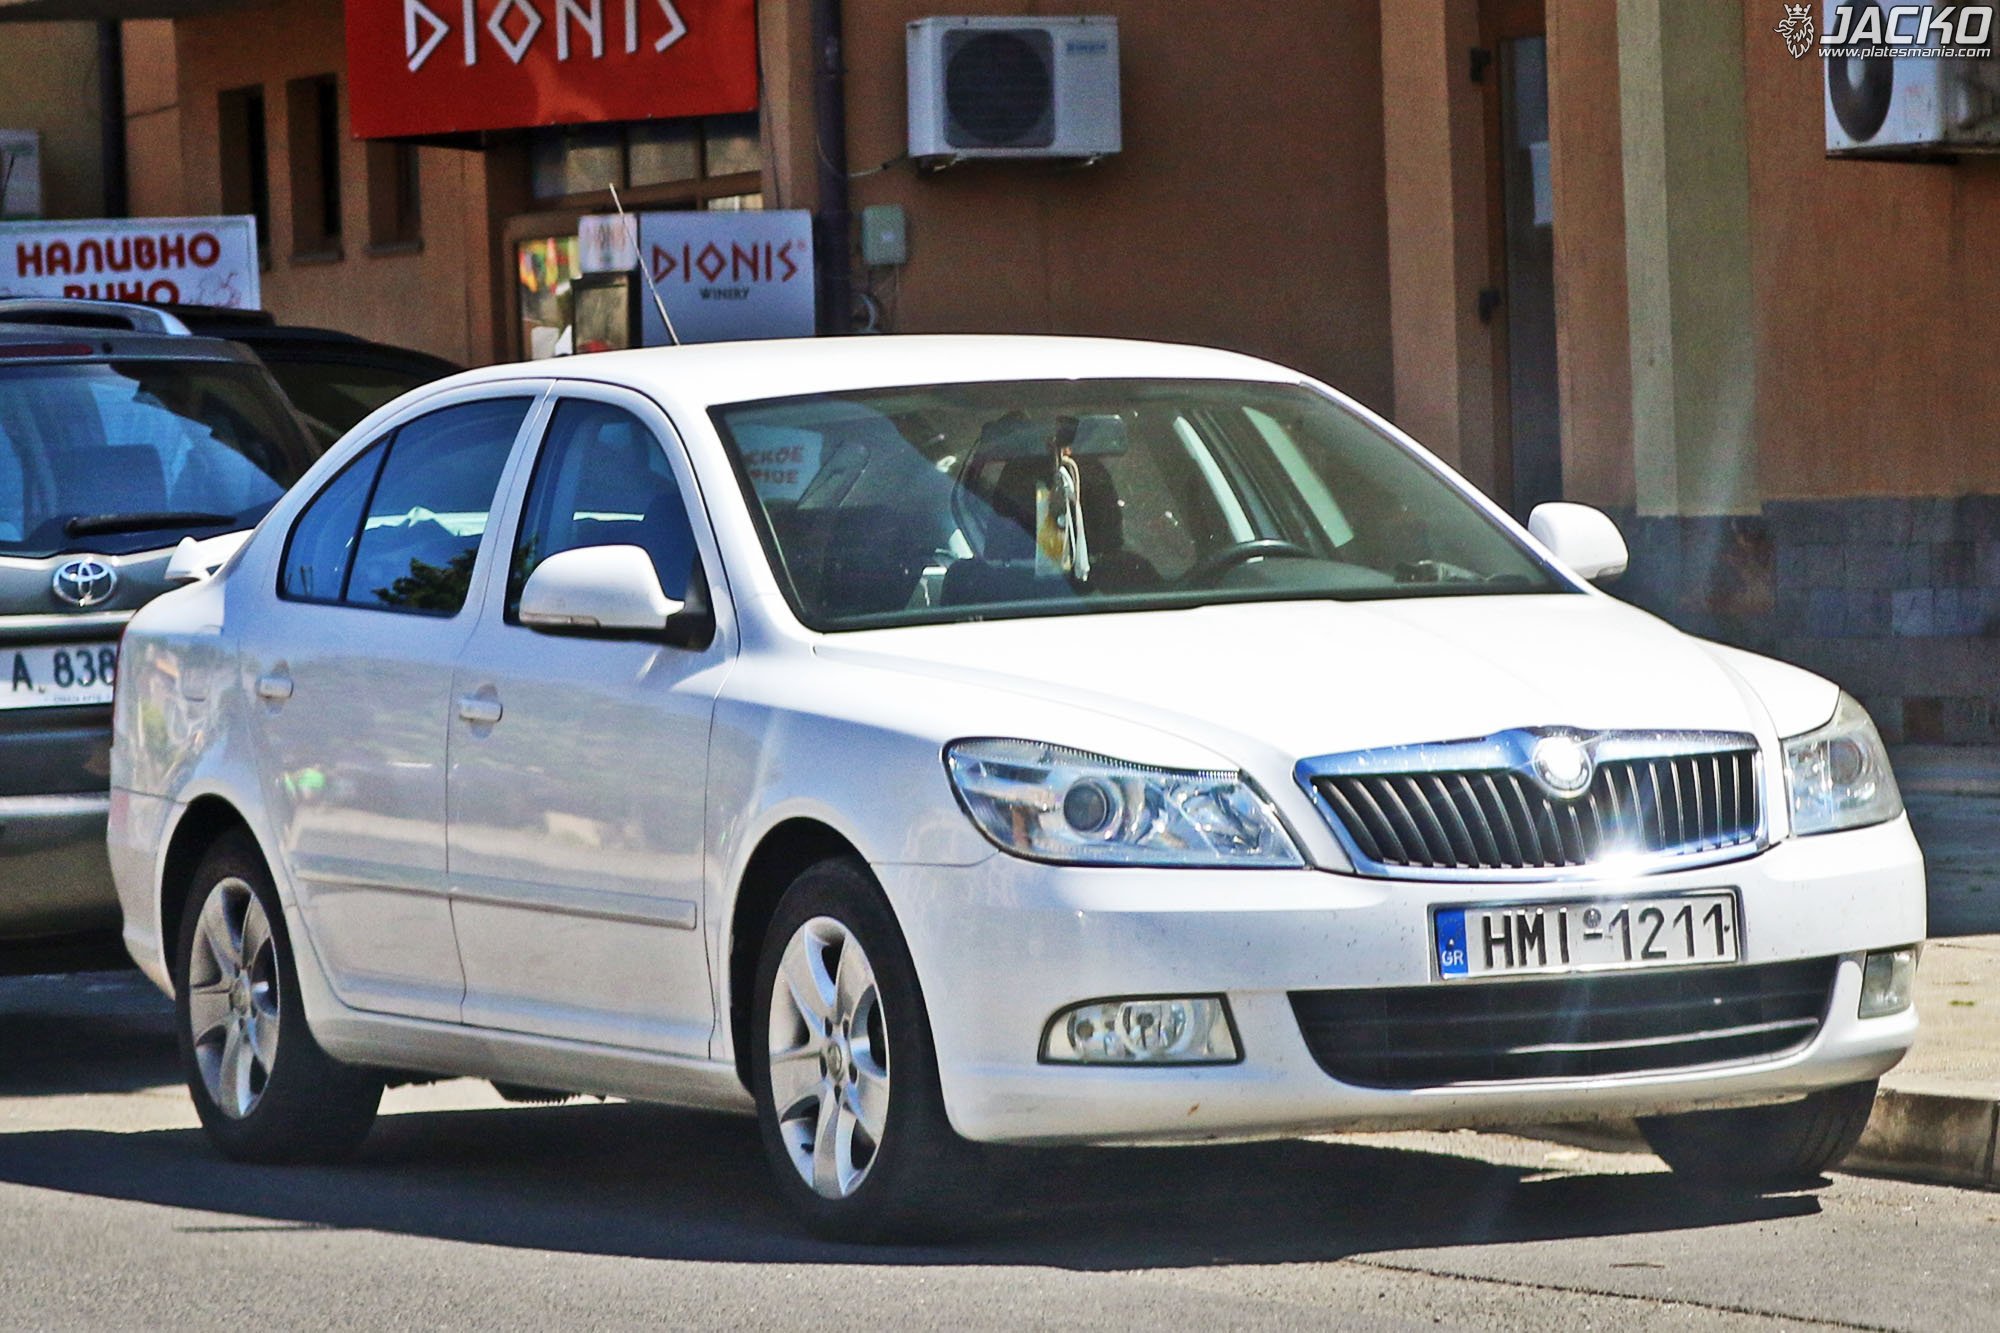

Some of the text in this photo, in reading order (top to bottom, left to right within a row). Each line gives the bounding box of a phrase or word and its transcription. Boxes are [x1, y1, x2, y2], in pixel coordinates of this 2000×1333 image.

[404, 0, 688, 72] DIONIS
[16, 232, 220, 277] НАЛИВНО
[652, 240, 798, 283] DIONIS
[700, 287, 750, 300] WINERY
[13, 652, 33, 692] A
[1441, 950, 1464, 966] GR
